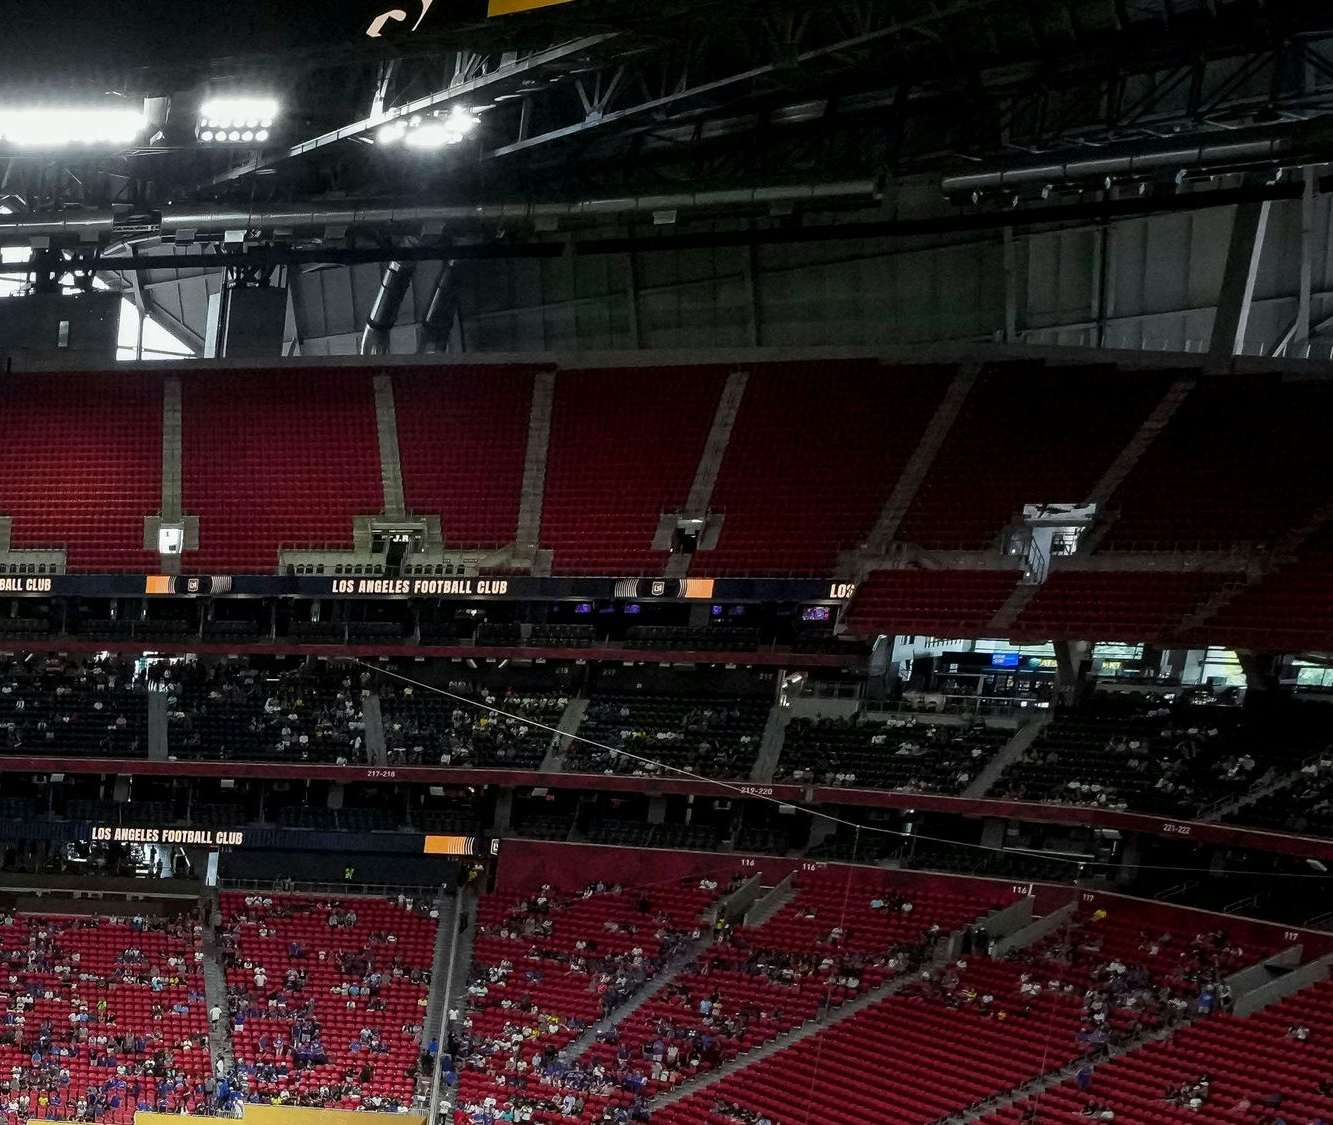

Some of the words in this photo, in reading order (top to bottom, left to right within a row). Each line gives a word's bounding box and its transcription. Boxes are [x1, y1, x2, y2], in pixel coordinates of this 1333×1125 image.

[26, 578, 51, 592] CLUB
[332, 580, 355, 593] LOS
[358, 580, 410, 594] ANGELES
[414, 580, 472, 594] FOOTBALL
[476, 581, 508, 595] CLUB
[91, 829, 111, 842] LOS
[114, 829, 159, 843] ANGELES
[162, 830, 212, 844] FOOTBALL
[215, 831, 243, 845] CLUB
